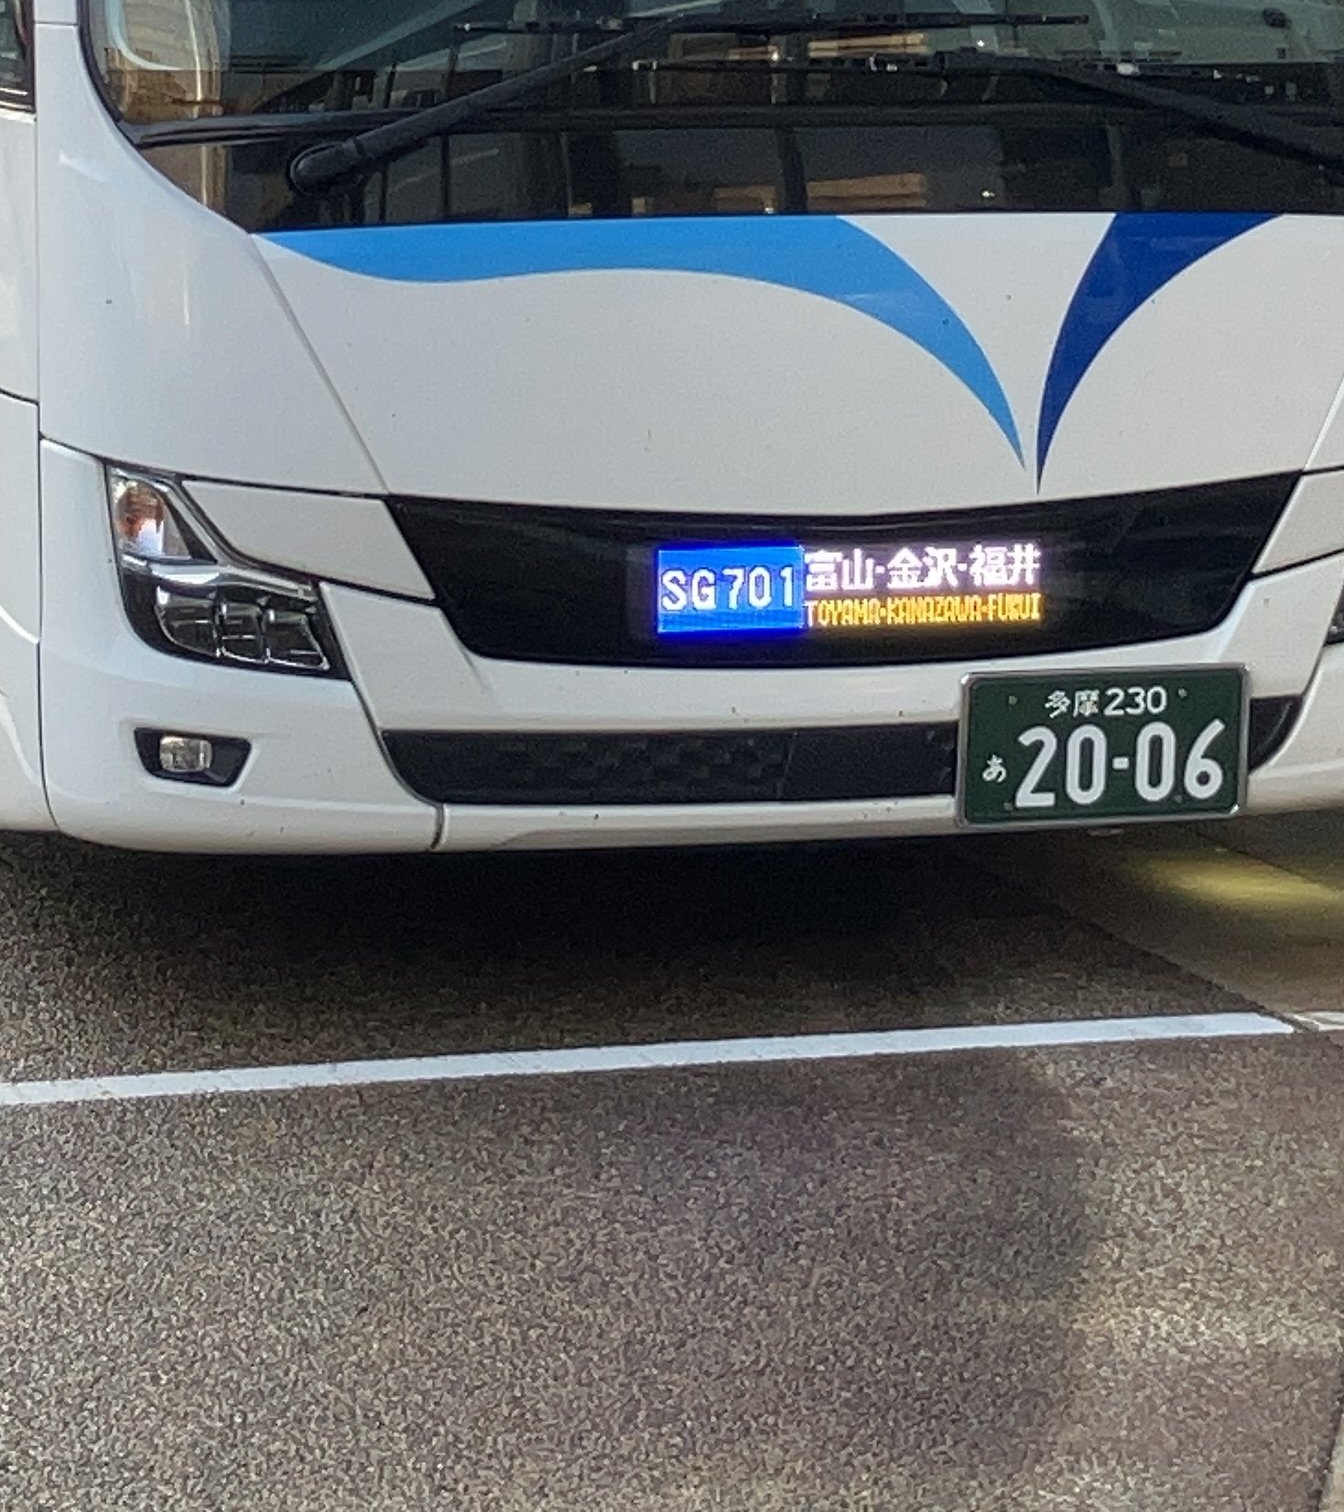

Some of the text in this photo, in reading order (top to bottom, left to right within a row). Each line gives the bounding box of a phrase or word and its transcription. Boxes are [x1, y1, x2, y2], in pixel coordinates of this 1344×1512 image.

[662, 566, 793, 610] SG701
[982, 718, 1225, 808] あ 20-06
